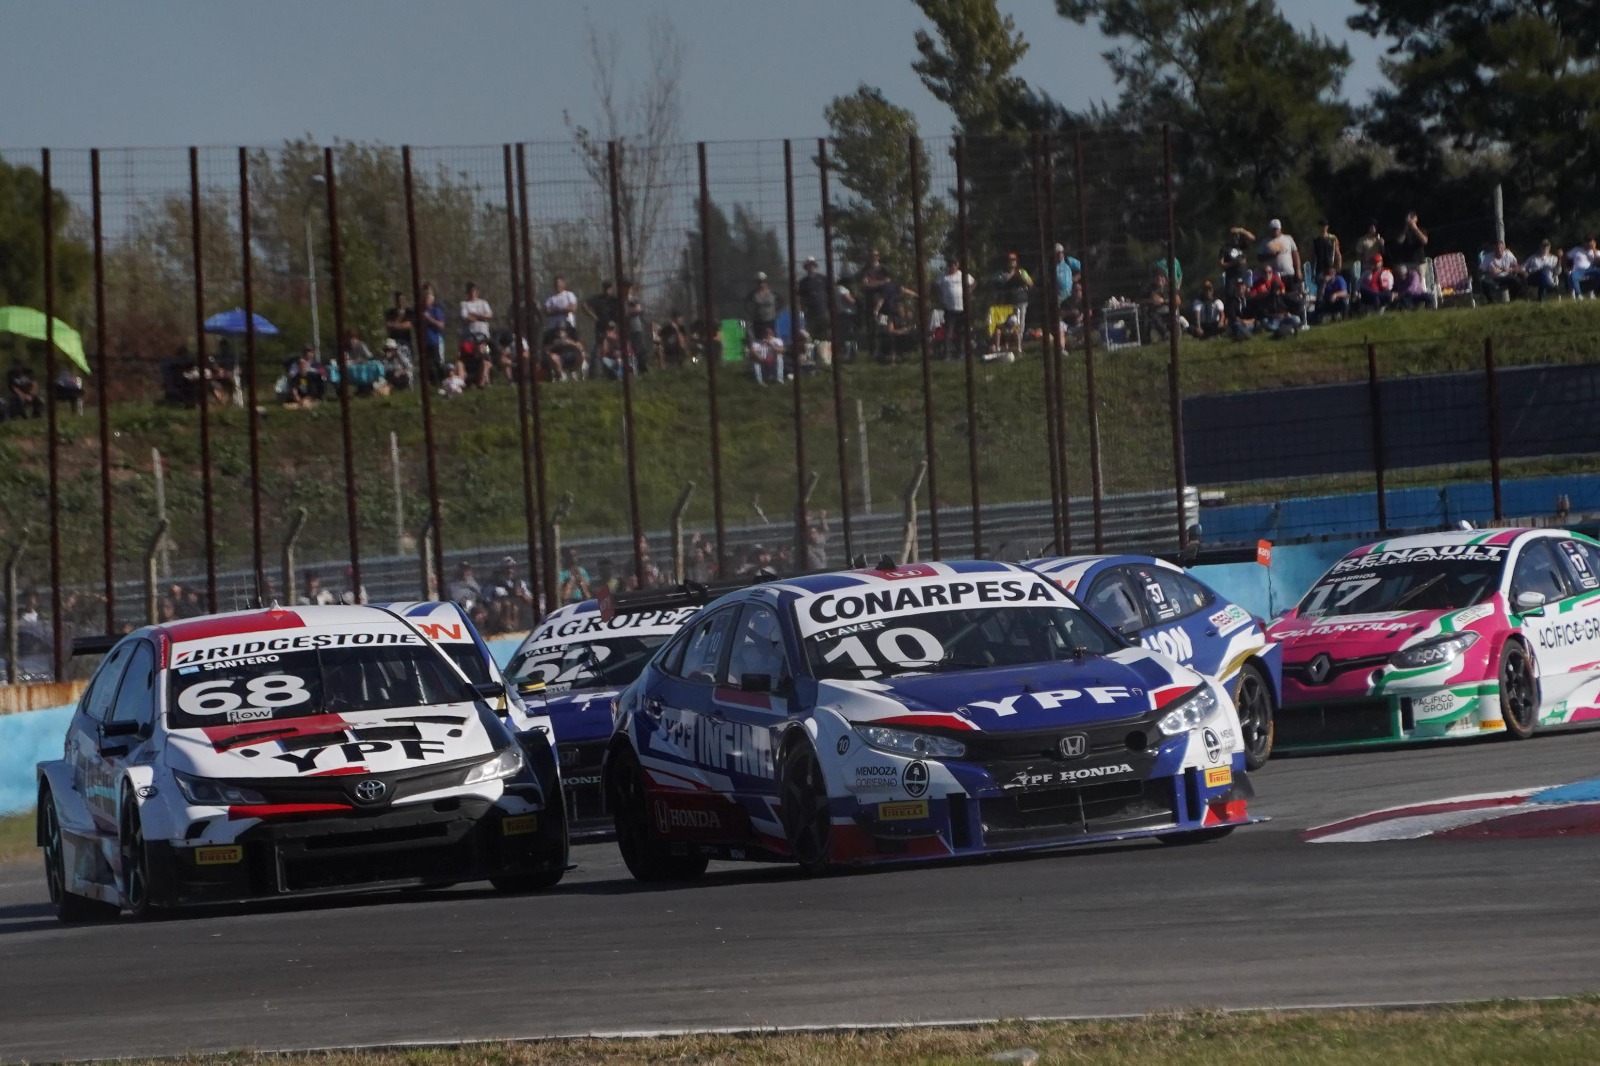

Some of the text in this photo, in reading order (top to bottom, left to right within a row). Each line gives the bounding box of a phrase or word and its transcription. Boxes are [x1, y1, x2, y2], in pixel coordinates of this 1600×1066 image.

[1332, 555, 1502, 574] CONCESIONARIOS
[1334, 545, 1507, 571] RENAULT
[1335, 573, 1377, 583] BARRIOS
[809, 580, 1057, 624] CONARPESA
[1147, 582, 1165, 604] 37
[1306, 578, 1382, 612] 17
[534, 606, 703, 643] AGROPEZ
[814, 620, 887, 642] LLAVER
[176, 632, 417, 666] BRIDGESTONE
[823, 627, 945, 679] 10
[203, 654, 280, 671] SANTERO
[516, 645, 612, 684] 52
[178, 675, 311, 716] 68
[967, 686, 1131, 717] YPF
[228, 709, 271, 721] flow
[1423, 702, 1454, 713] GROUP
[838, 736, 850, 751] 10
[271, 740, 445, 773] YPF
[855, 766, 898, 776] MENDOZA
[1060, 763, 1135, 781] HONDA
[1208, 769, 1231, 783] PIRELLI
[855, 777, 898, 788] GOBIERNO
[669, 808, 721, 829] HONDA
[882, 803, 924, 818] PIRELLI
